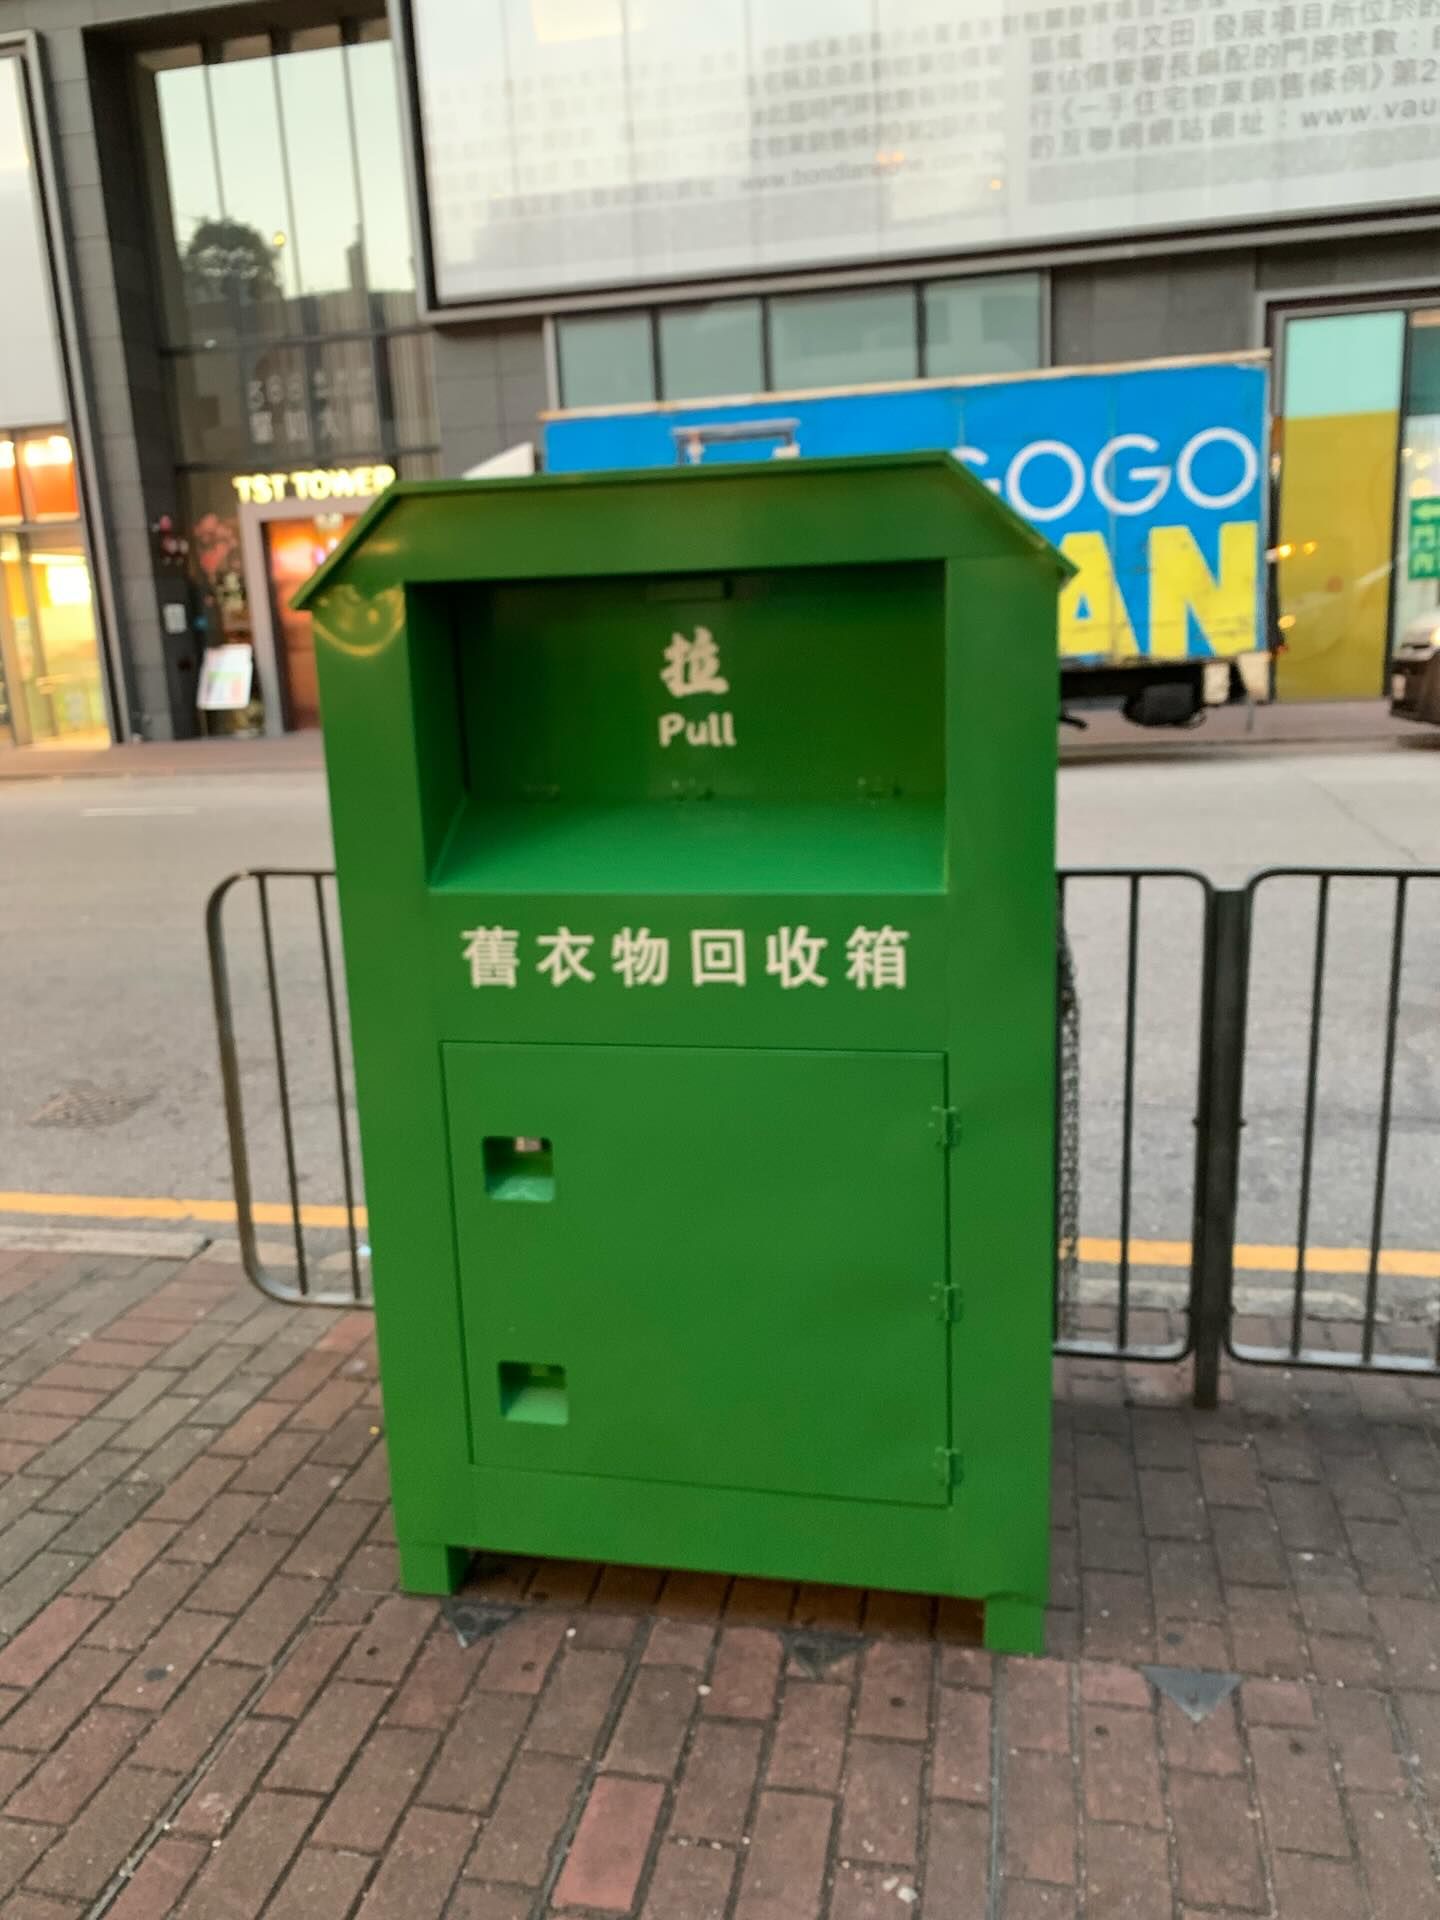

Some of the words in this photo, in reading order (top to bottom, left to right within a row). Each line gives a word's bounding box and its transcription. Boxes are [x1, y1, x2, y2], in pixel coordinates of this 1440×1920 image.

[232, 472, 288, 504] TST
[290, 464, 396, 501] TOWER
[661, 625, 729, 698] 拉
[659, 711, 737, 747] Pull
[461, 926, 909, 989] 舊衣物回收箱
